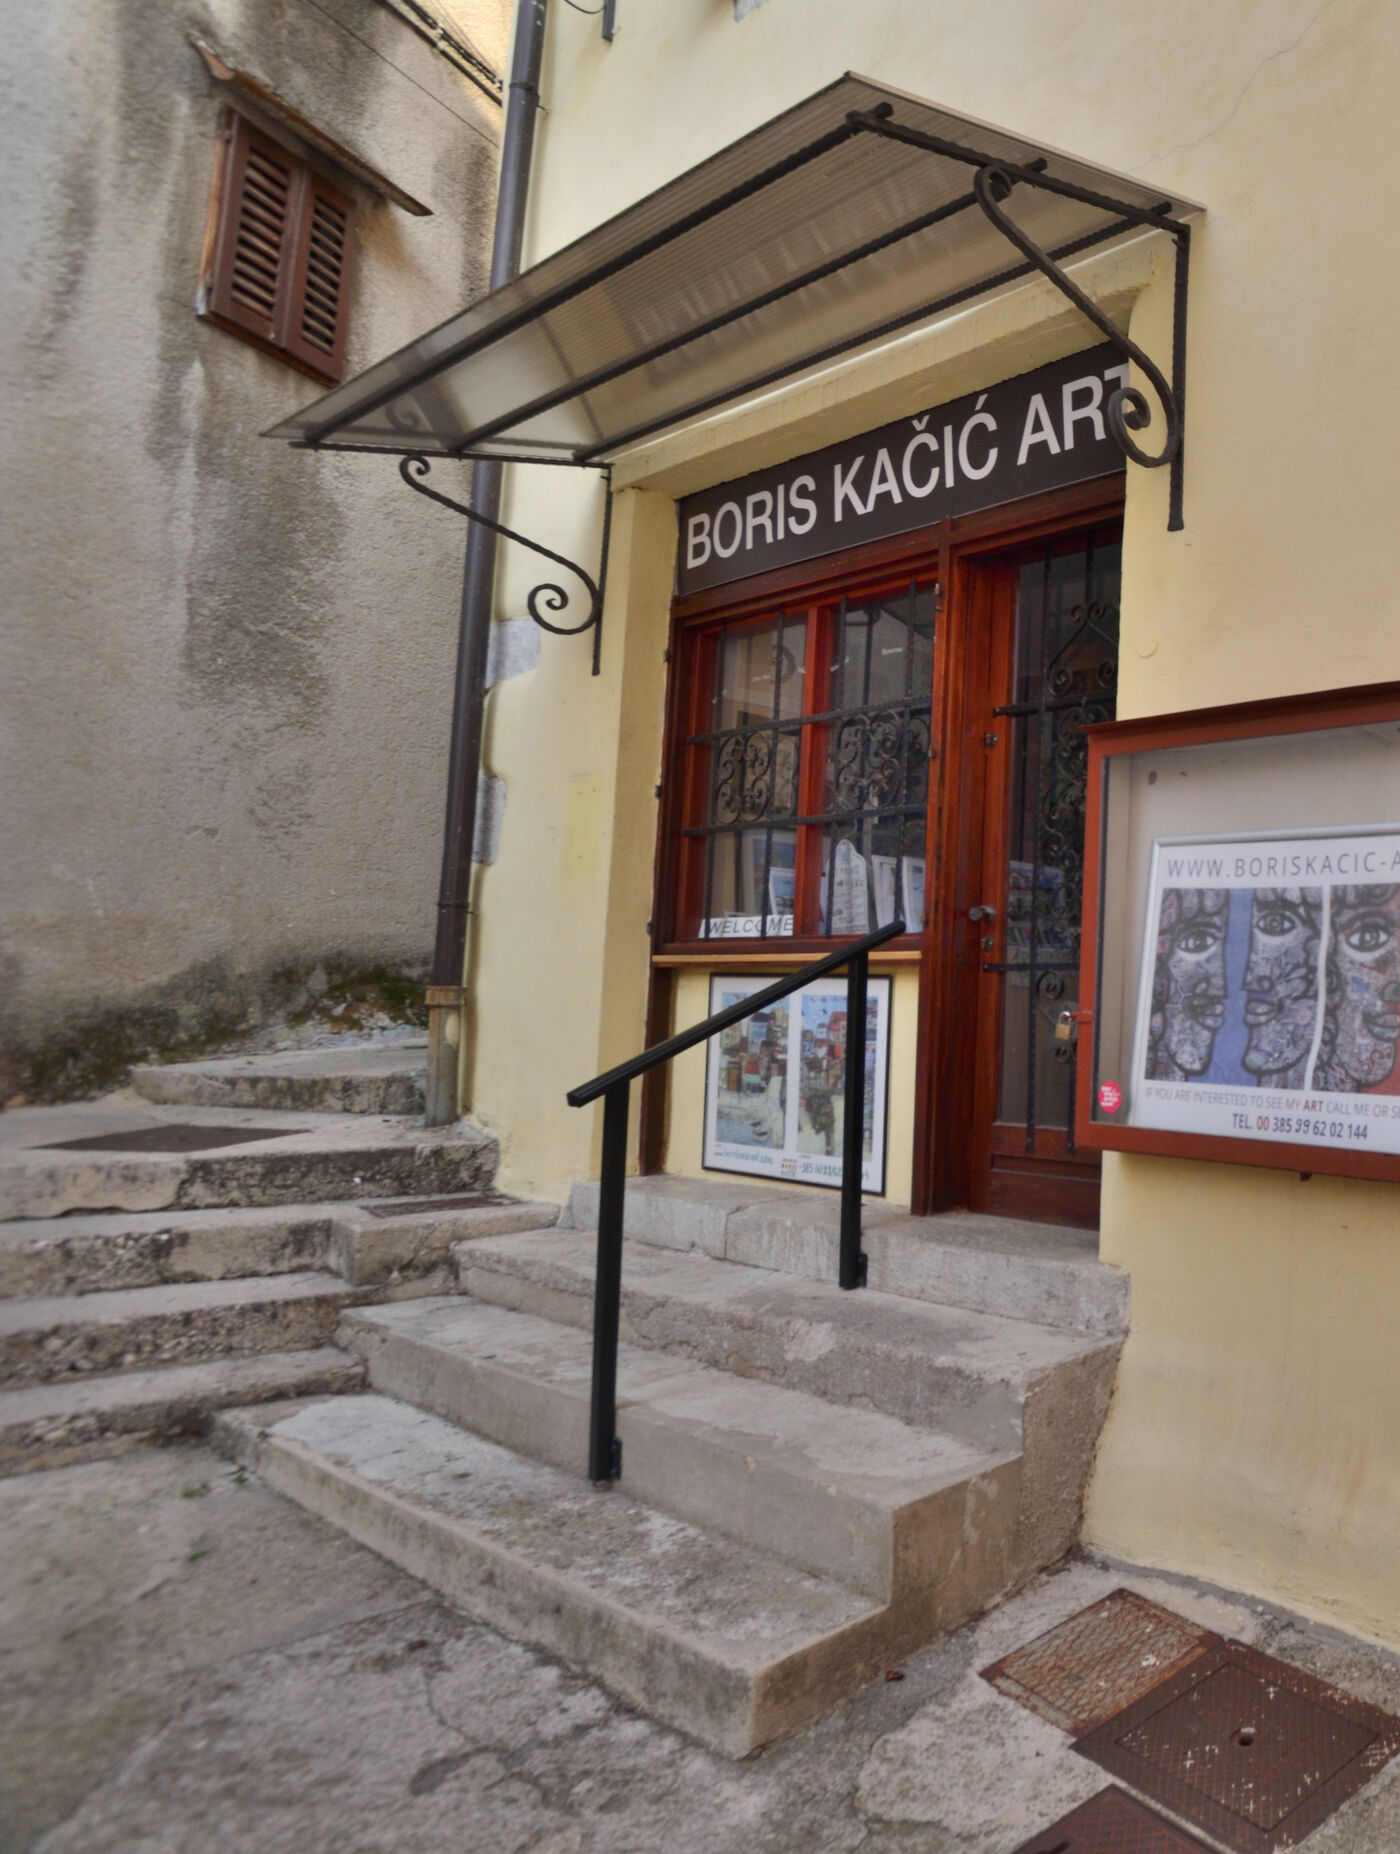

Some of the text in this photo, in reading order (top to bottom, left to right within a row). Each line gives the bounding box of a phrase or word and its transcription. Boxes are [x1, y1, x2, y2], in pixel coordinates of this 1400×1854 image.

[686, 474, 817, 570] BORIS
[833, 394, 998, 522] KAČIĆ
[709, 917, 793, 934] WELCOME
[1155, 1088, 1173, 1100] YOU
[1174, 1089, 1192, 1102] ARE
[1193, 1091, 1248, 1106] INTERESTED
[1250, 1095, 1263, 1108] TO
[1265, 1096, 1282, 1110] SEE
[1286, 1098, 1300, 1110] MY
[1303, 1099, 1324, 1113] ART
[1326, 1100, 1351, 1115] CALL
[1354, 1103, 1370, 1117] ME
[1372, 1104, 1389, 1118] OR
[1232, 1113, 1368, 1139] TEL. 00 385 99 62 02 144
